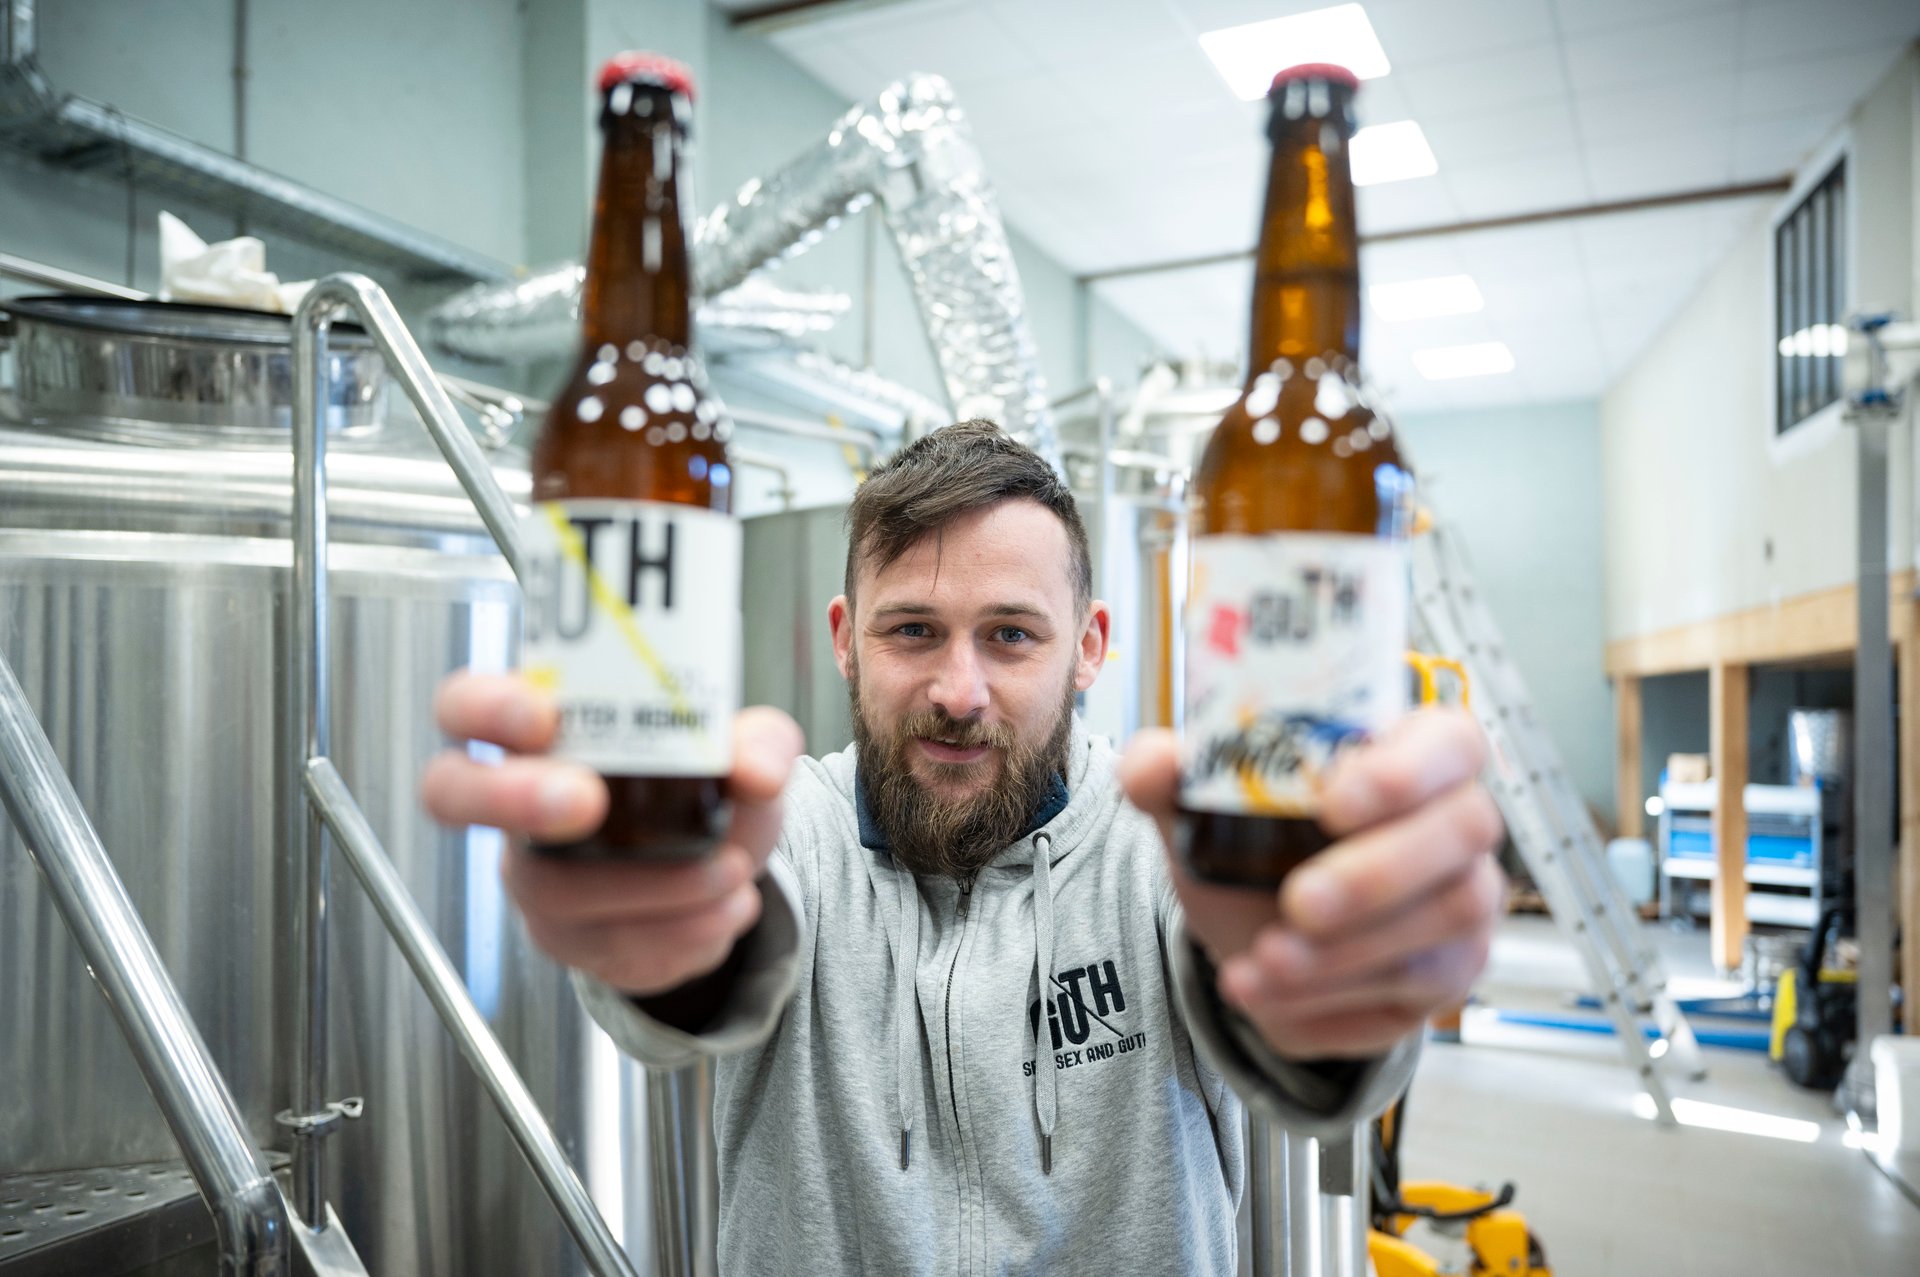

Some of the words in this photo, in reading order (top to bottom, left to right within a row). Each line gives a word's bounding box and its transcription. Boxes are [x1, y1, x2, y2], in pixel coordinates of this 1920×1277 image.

[1030, 960, 1126, 1050] GUTH
[1055, 1050, 1083, 1069] SEX
[1086, 1043, 1115, 1063] AND
